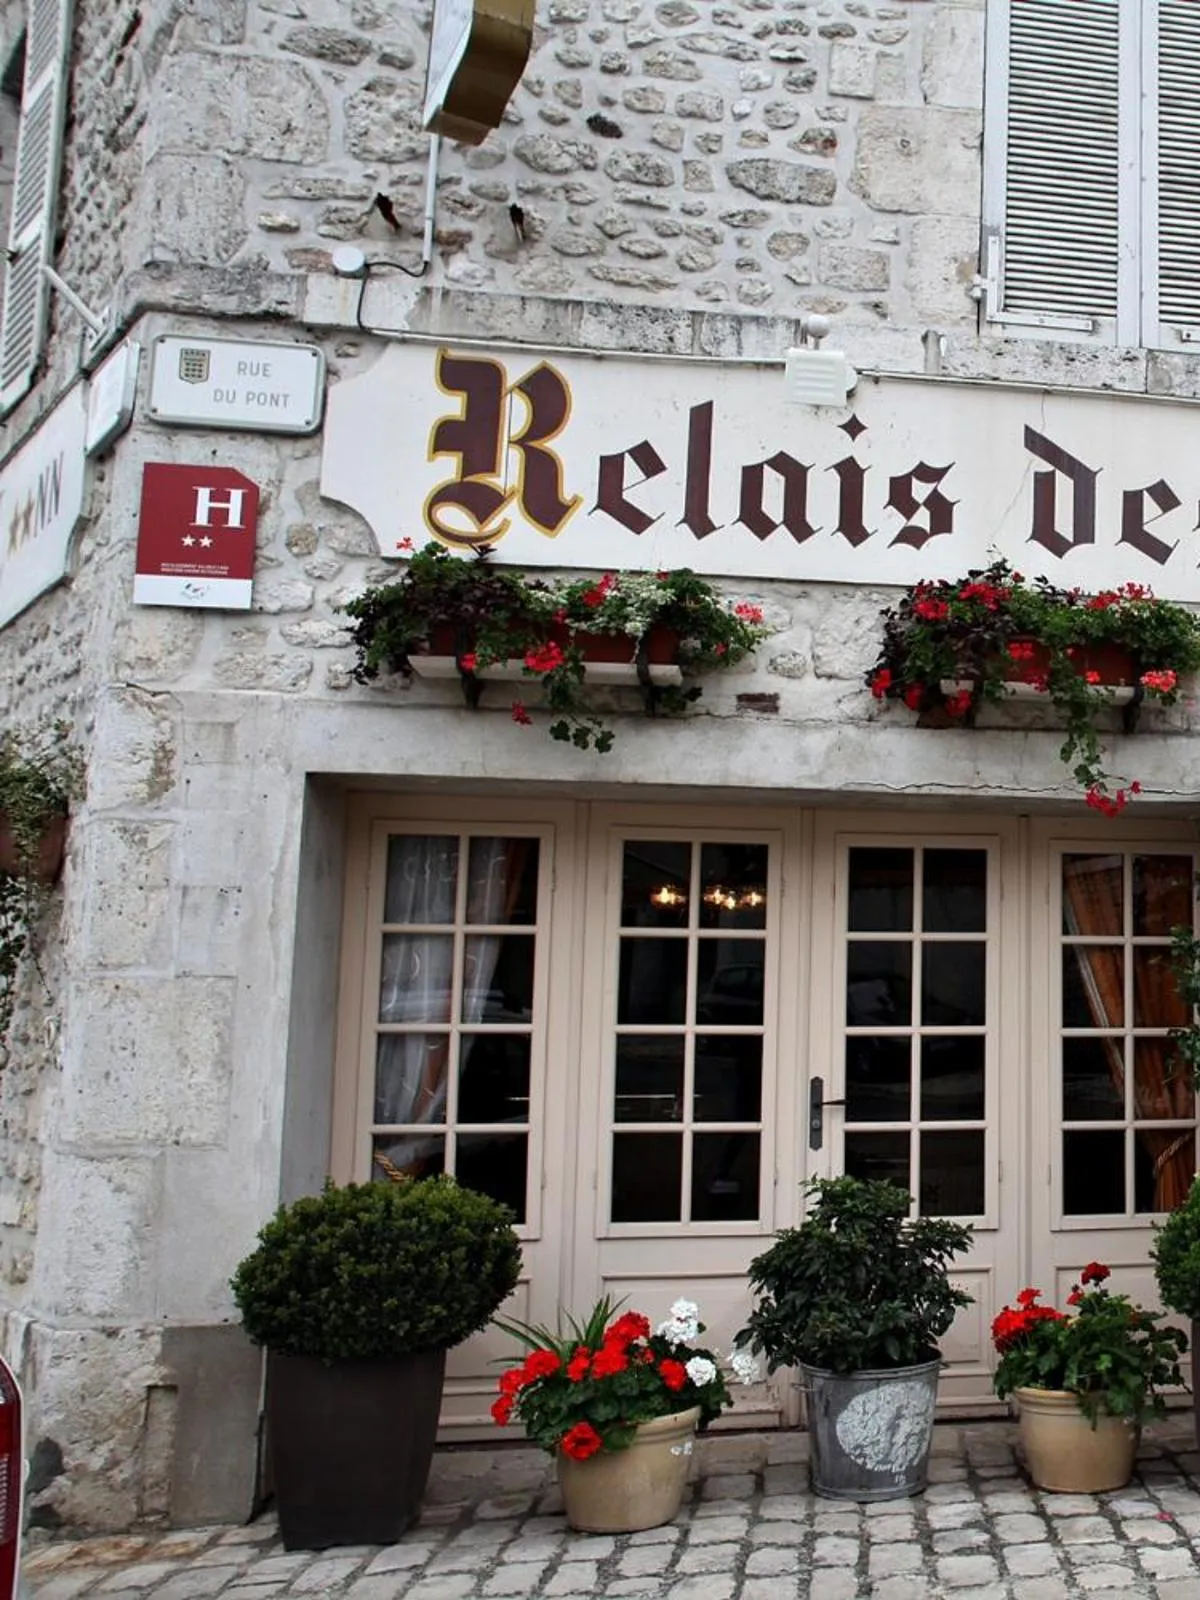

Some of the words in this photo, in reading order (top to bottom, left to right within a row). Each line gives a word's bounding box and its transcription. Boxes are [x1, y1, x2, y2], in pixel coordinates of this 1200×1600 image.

[237, 360, 272, 378] RUE
[213, 389, 236, 404] DU
[245, 392, 291, 409] PONT
[422, 346, 961, 550] Relais
[189, 486, 248, 529] H
